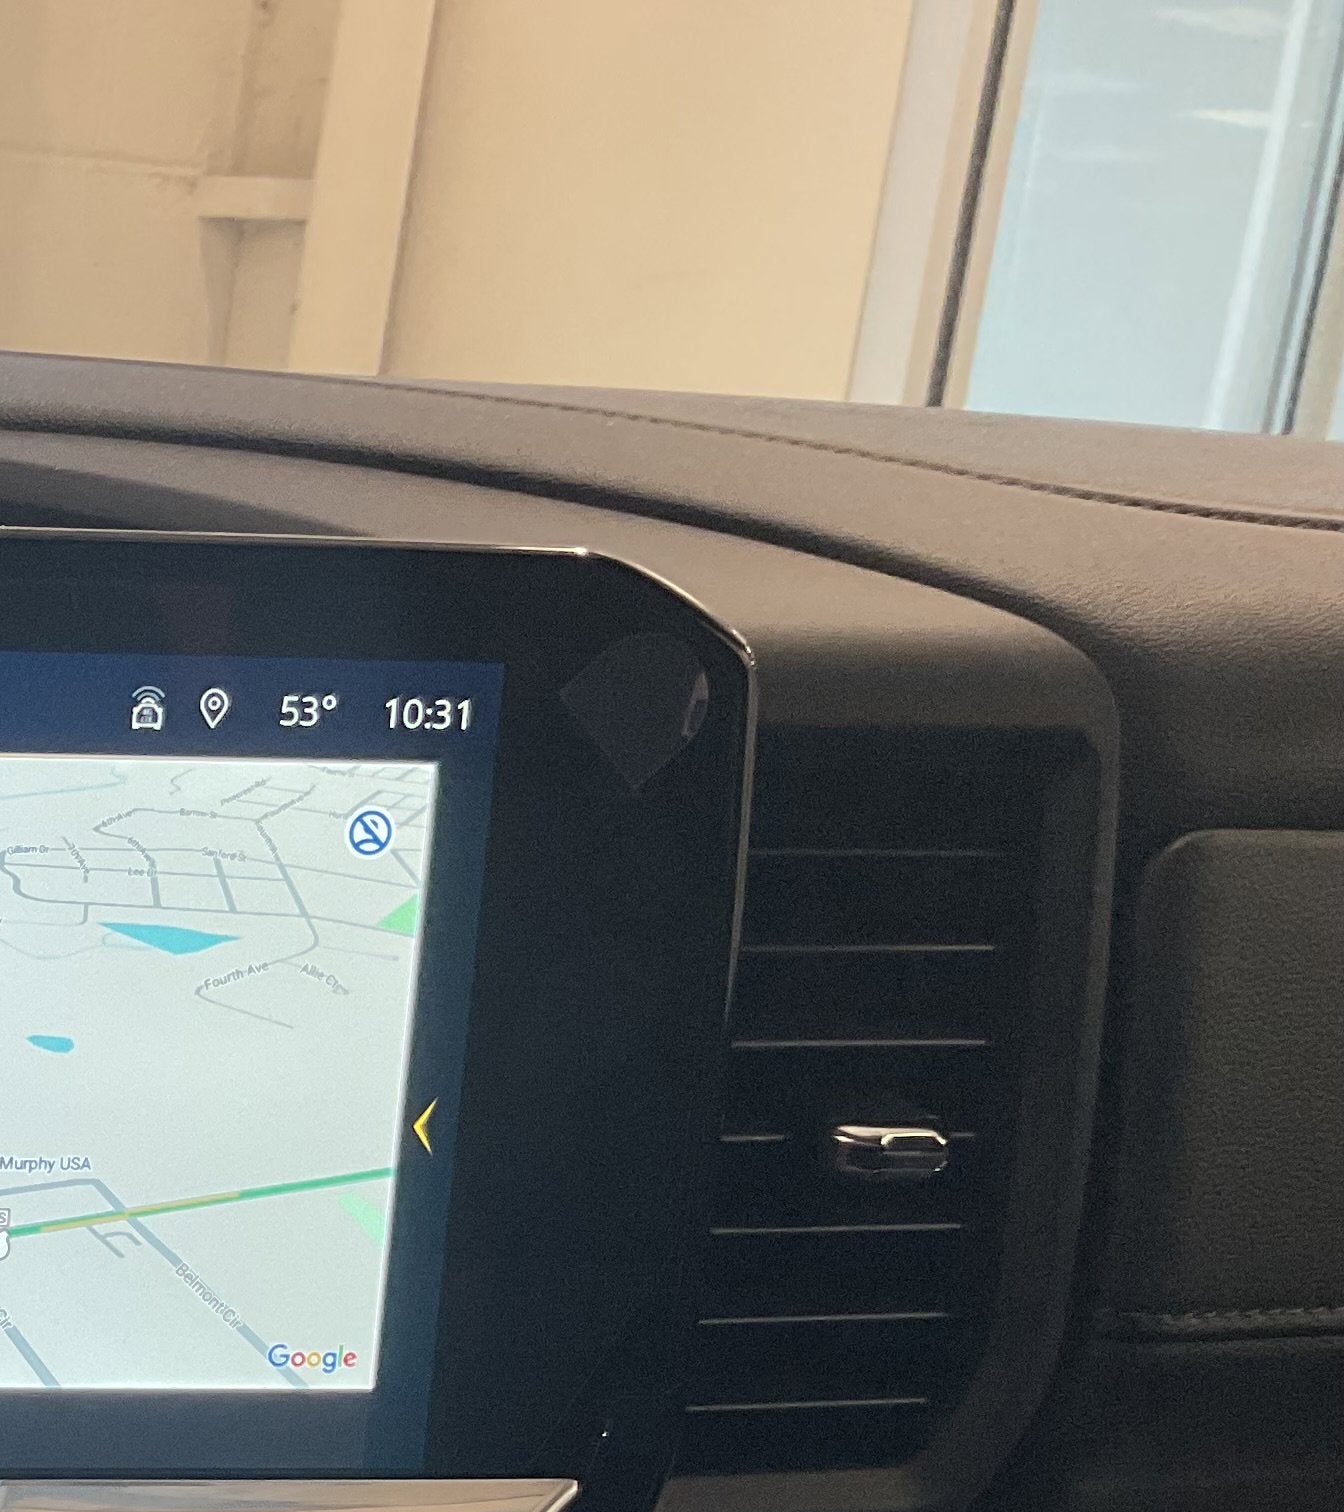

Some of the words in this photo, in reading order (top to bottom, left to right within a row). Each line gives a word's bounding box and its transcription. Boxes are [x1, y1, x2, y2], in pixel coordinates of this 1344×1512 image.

[279, 693, 338, 727] 53°
[384, 697, 472, 731] 10:31
[203, 968, 244, 991] Fourth
[247, 961, 269, 976] Ave
[59, 1156, 92, 1171] USA
[174, 1261, 226, 1314] Belmont
[267, 1343, 358, 1374] Google
